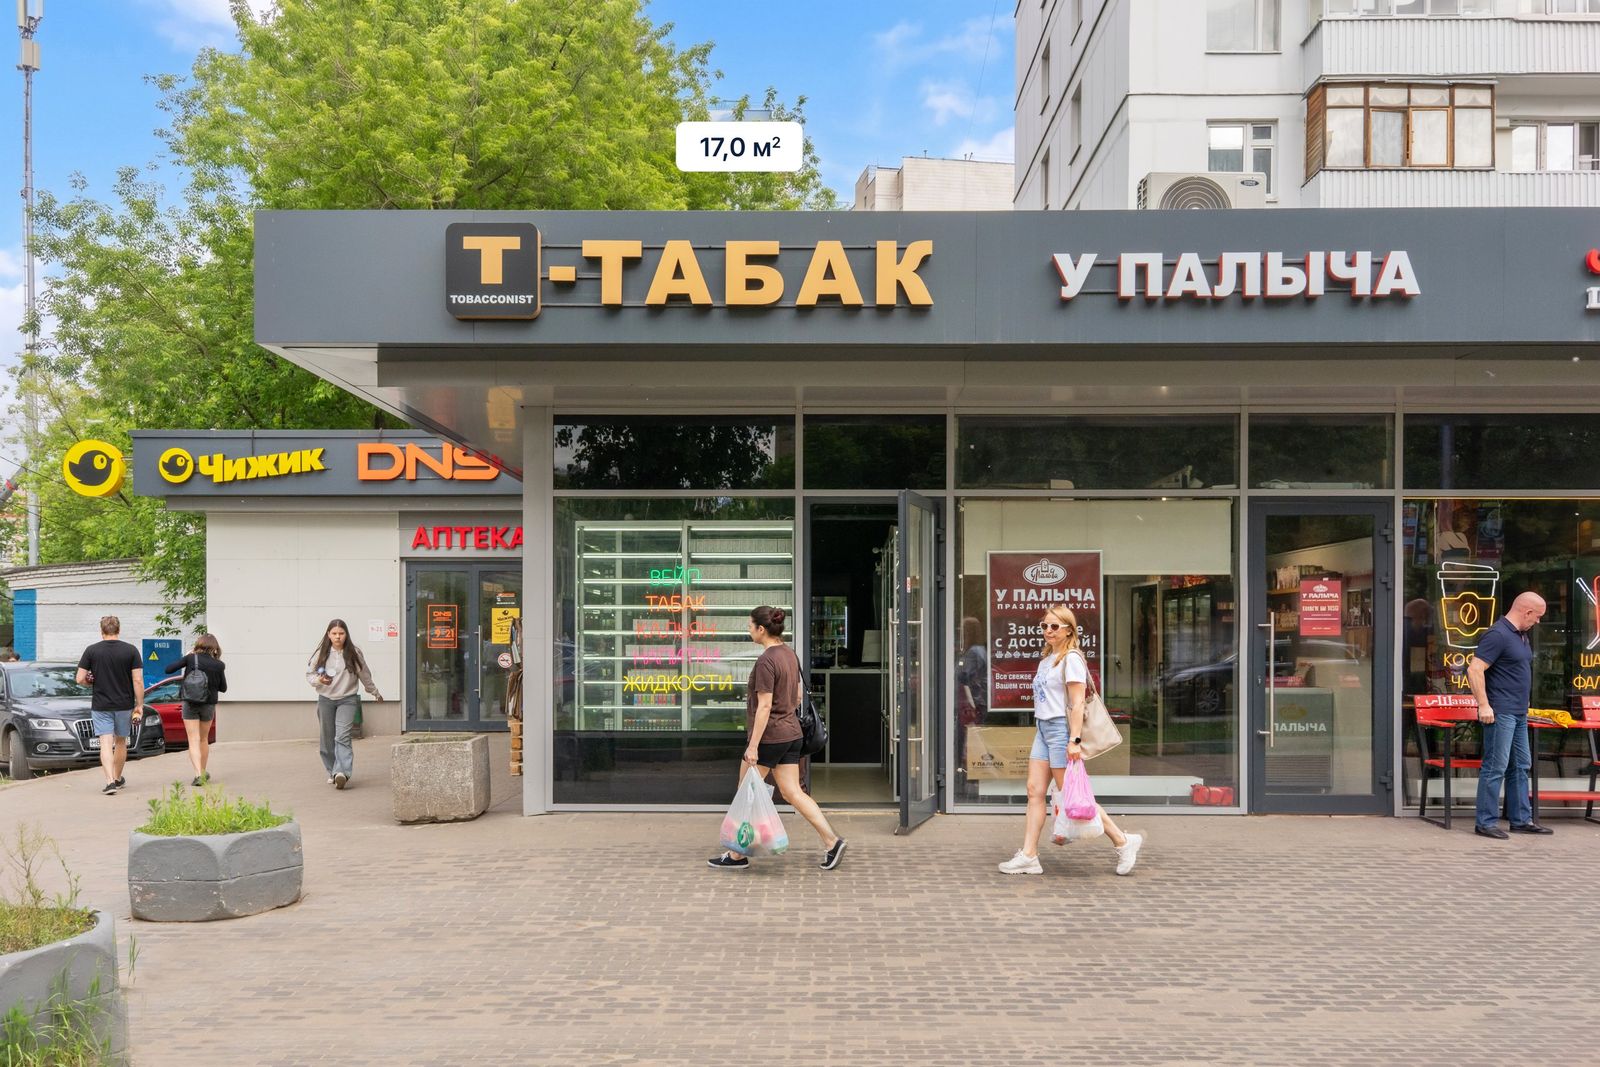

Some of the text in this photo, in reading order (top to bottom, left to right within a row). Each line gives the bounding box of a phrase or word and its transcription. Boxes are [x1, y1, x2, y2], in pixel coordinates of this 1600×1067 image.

[1051, 250, 1421, 299] У ПАЛЫЧА
[450, 295, 534, 304] TOBACCONIST
[198, 447, 326, 483] Чижик
[357, 443, 500, 480] DNS
[412, 526, 523, 550] АПТЕКА
[650, 565, 700, 586] ВЕЙП
[645, 595, 706, 612] ТАБАК
[995, 588, 1095, 602] У ПАЛЫЧА
[636, 622, 718, 639] КАЛЬЯН
[1008, 623, 1084, 636] Закае
[995, 635, 1096, 649] с достй!
[623, 674, 734, 694] ЖИДКОСТИ
[995, 672, 1008, 680] Все
[1451, 674, 1471, 689] ЧА
[995, 682, 1018, 690] Вашем
